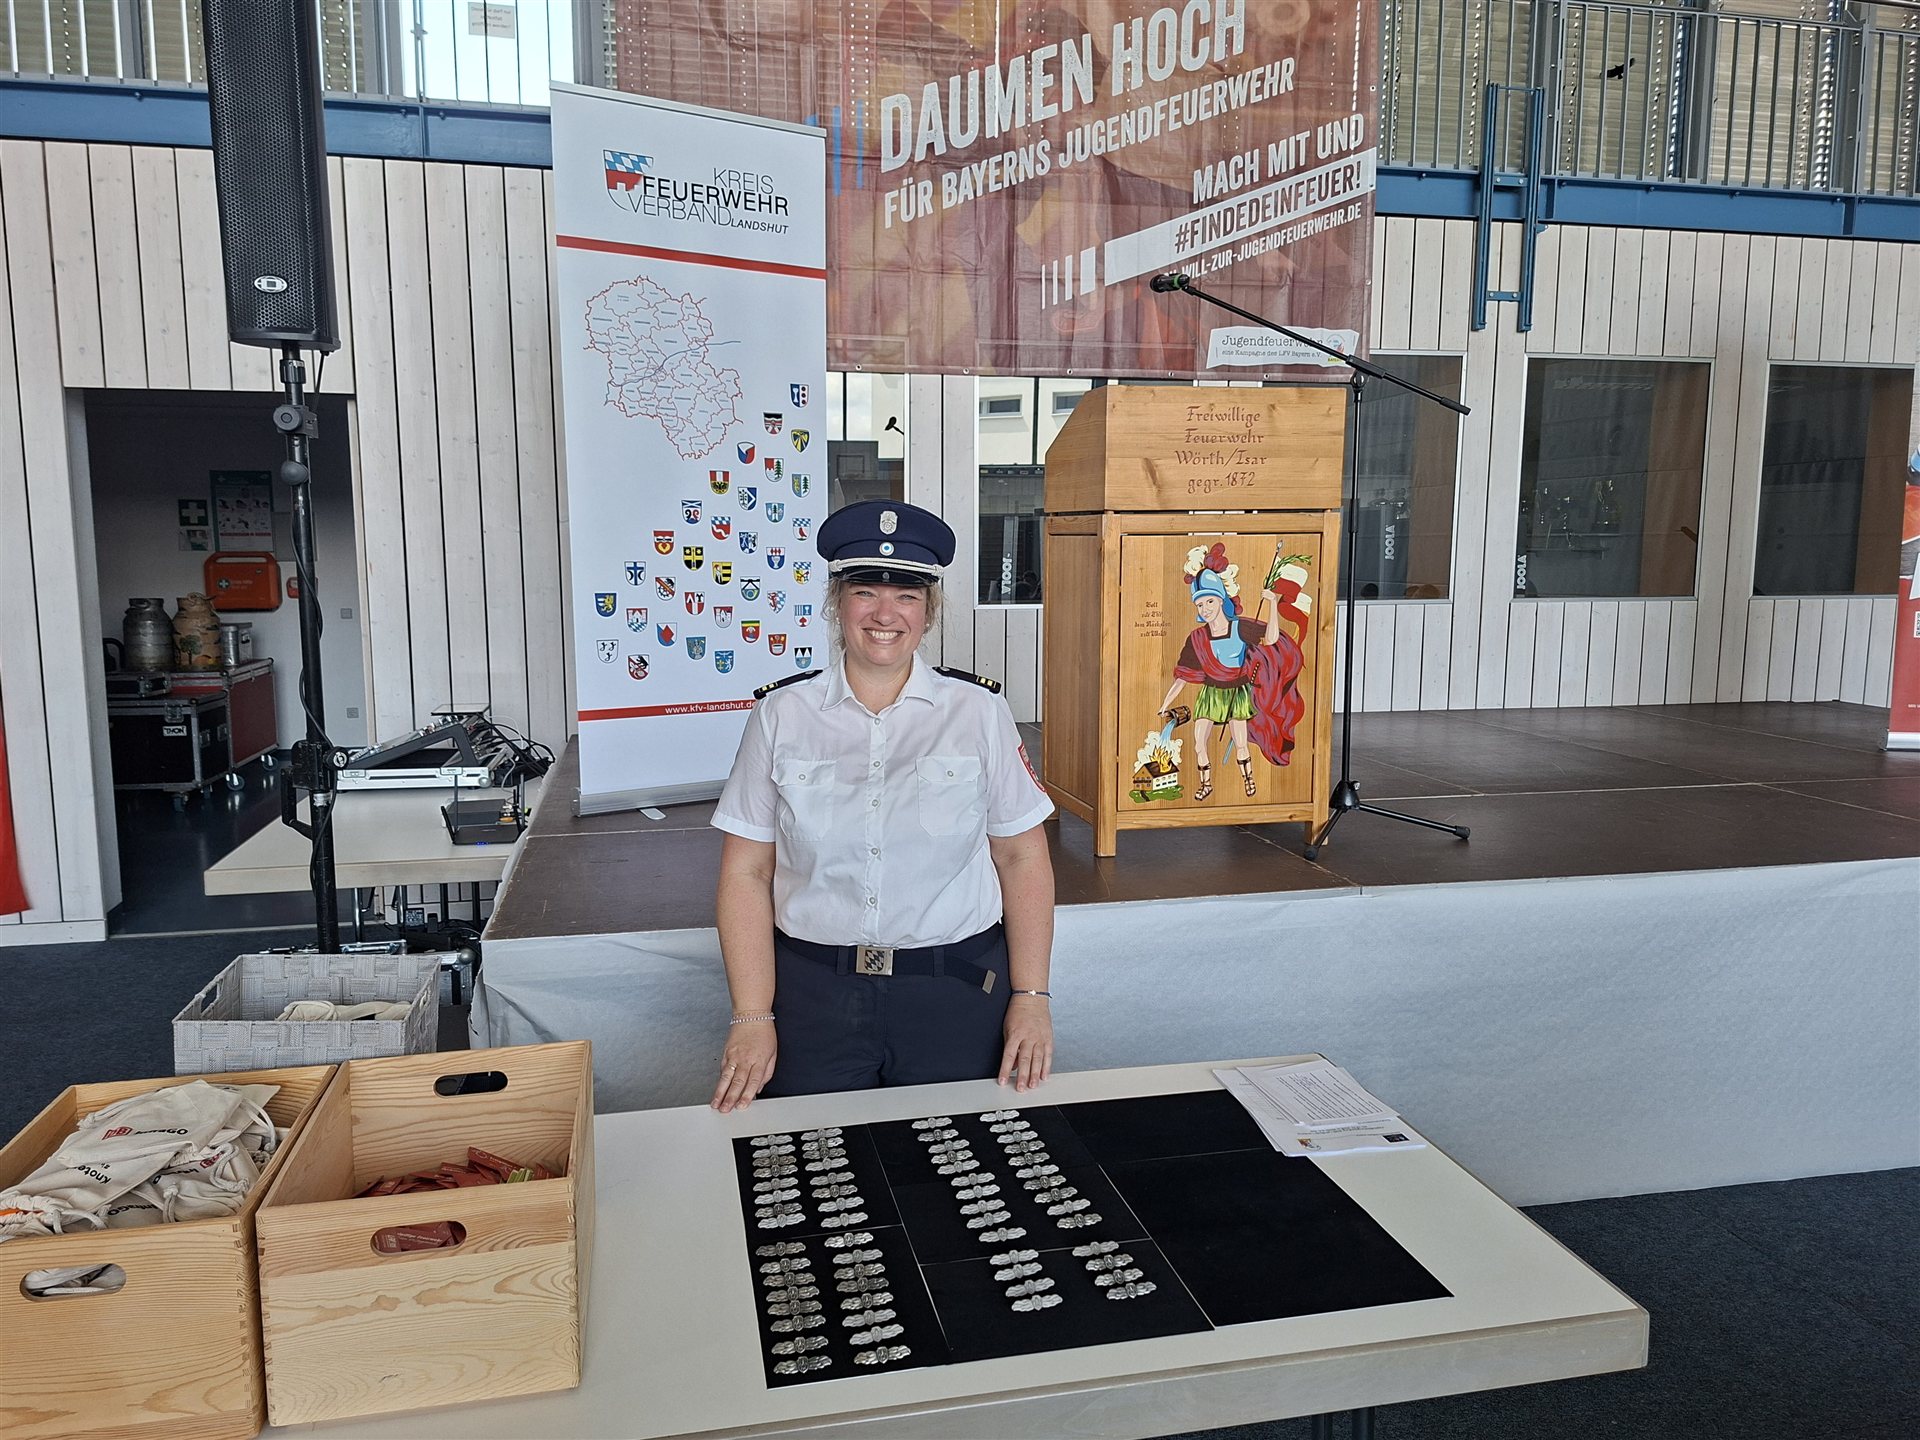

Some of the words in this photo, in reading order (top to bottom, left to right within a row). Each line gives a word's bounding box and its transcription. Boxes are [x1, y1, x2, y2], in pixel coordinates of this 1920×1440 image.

[880, 34, 1095, 173] DAUMEN
[1111, 0, 1246, 97] HOCH
[884, 175, 934, 229] FÜR
[942, 139, 1051, 209] BAYERNS
[1059, 57, 1296, 169] JUGENDFEUERWEHR
[1192, 148, 1260, 205] MACH
[1268, 132, 1309, 175] MIT
[1316, 113, 1364, 160] UND
[643, 175, 789, 217] FEUERWEHR
[713, 167, 774, 194] KREIS
[627, 192, 732, 226] VERBAND
[731, 217, 789, 235] LANDSHUT
[1174, 160, 1362, 254] #FINDEDEINFEUER!
[1184, 428, 1265, 444] Feuerwehr
[1186, 406, 1261, 428] Freiwillige
[1174, 448, 1268, 467] Wörth/Isar
[1187, 477, 1223, 494] gegr.
[1224, 472, 1256, 487] 1872
